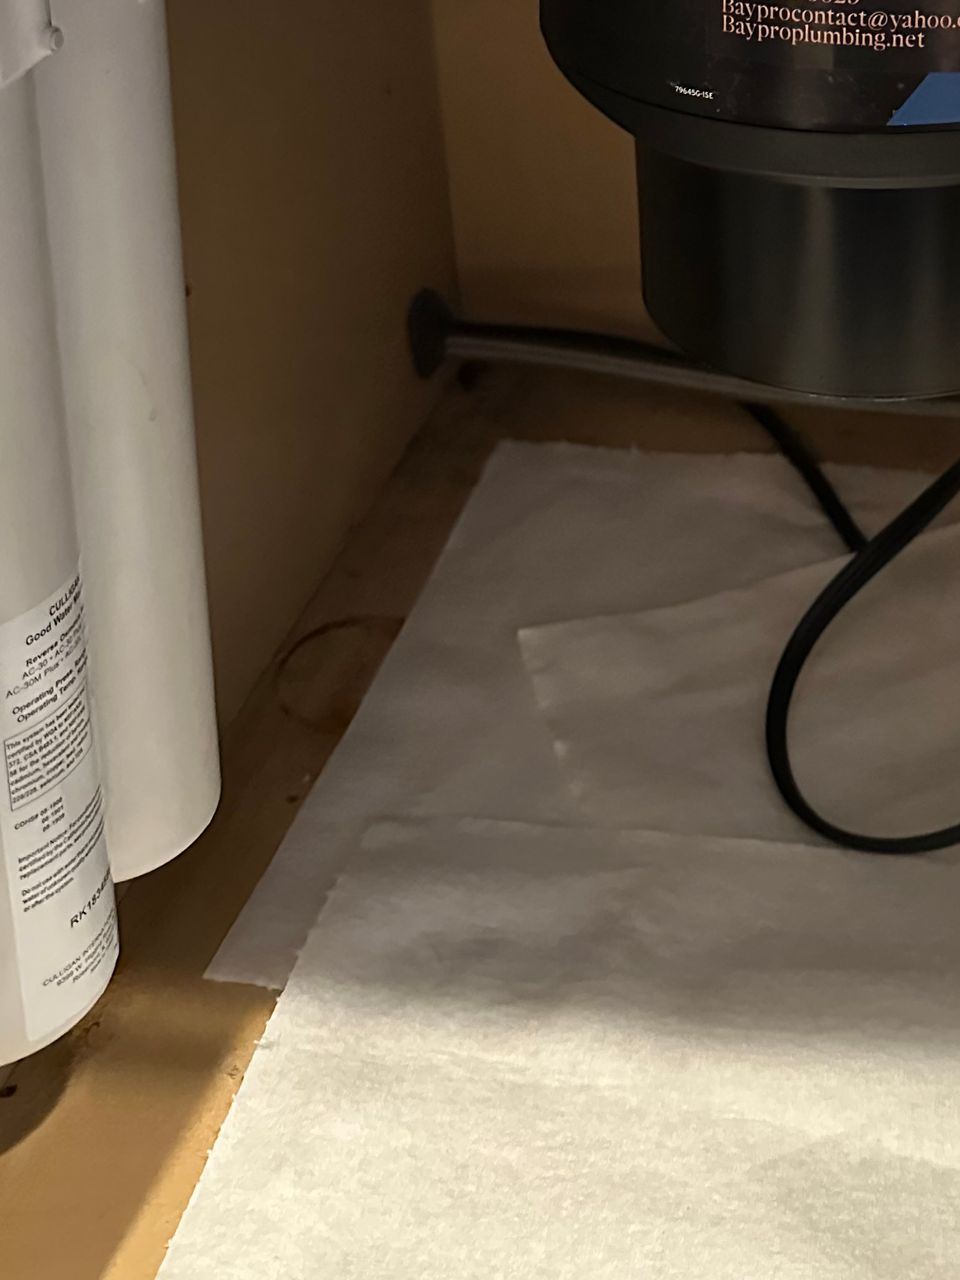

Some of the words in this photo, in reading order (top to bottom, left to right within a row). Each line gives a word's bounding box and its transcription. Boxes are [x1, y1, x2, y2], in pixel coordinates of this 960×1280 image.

[721, 14, 926, 51] Bayproplumbing.net
[26, 621, 52, 646] Good
[12, 685, 54, 715] Operating
[17, 693, 58, 723] Operating
